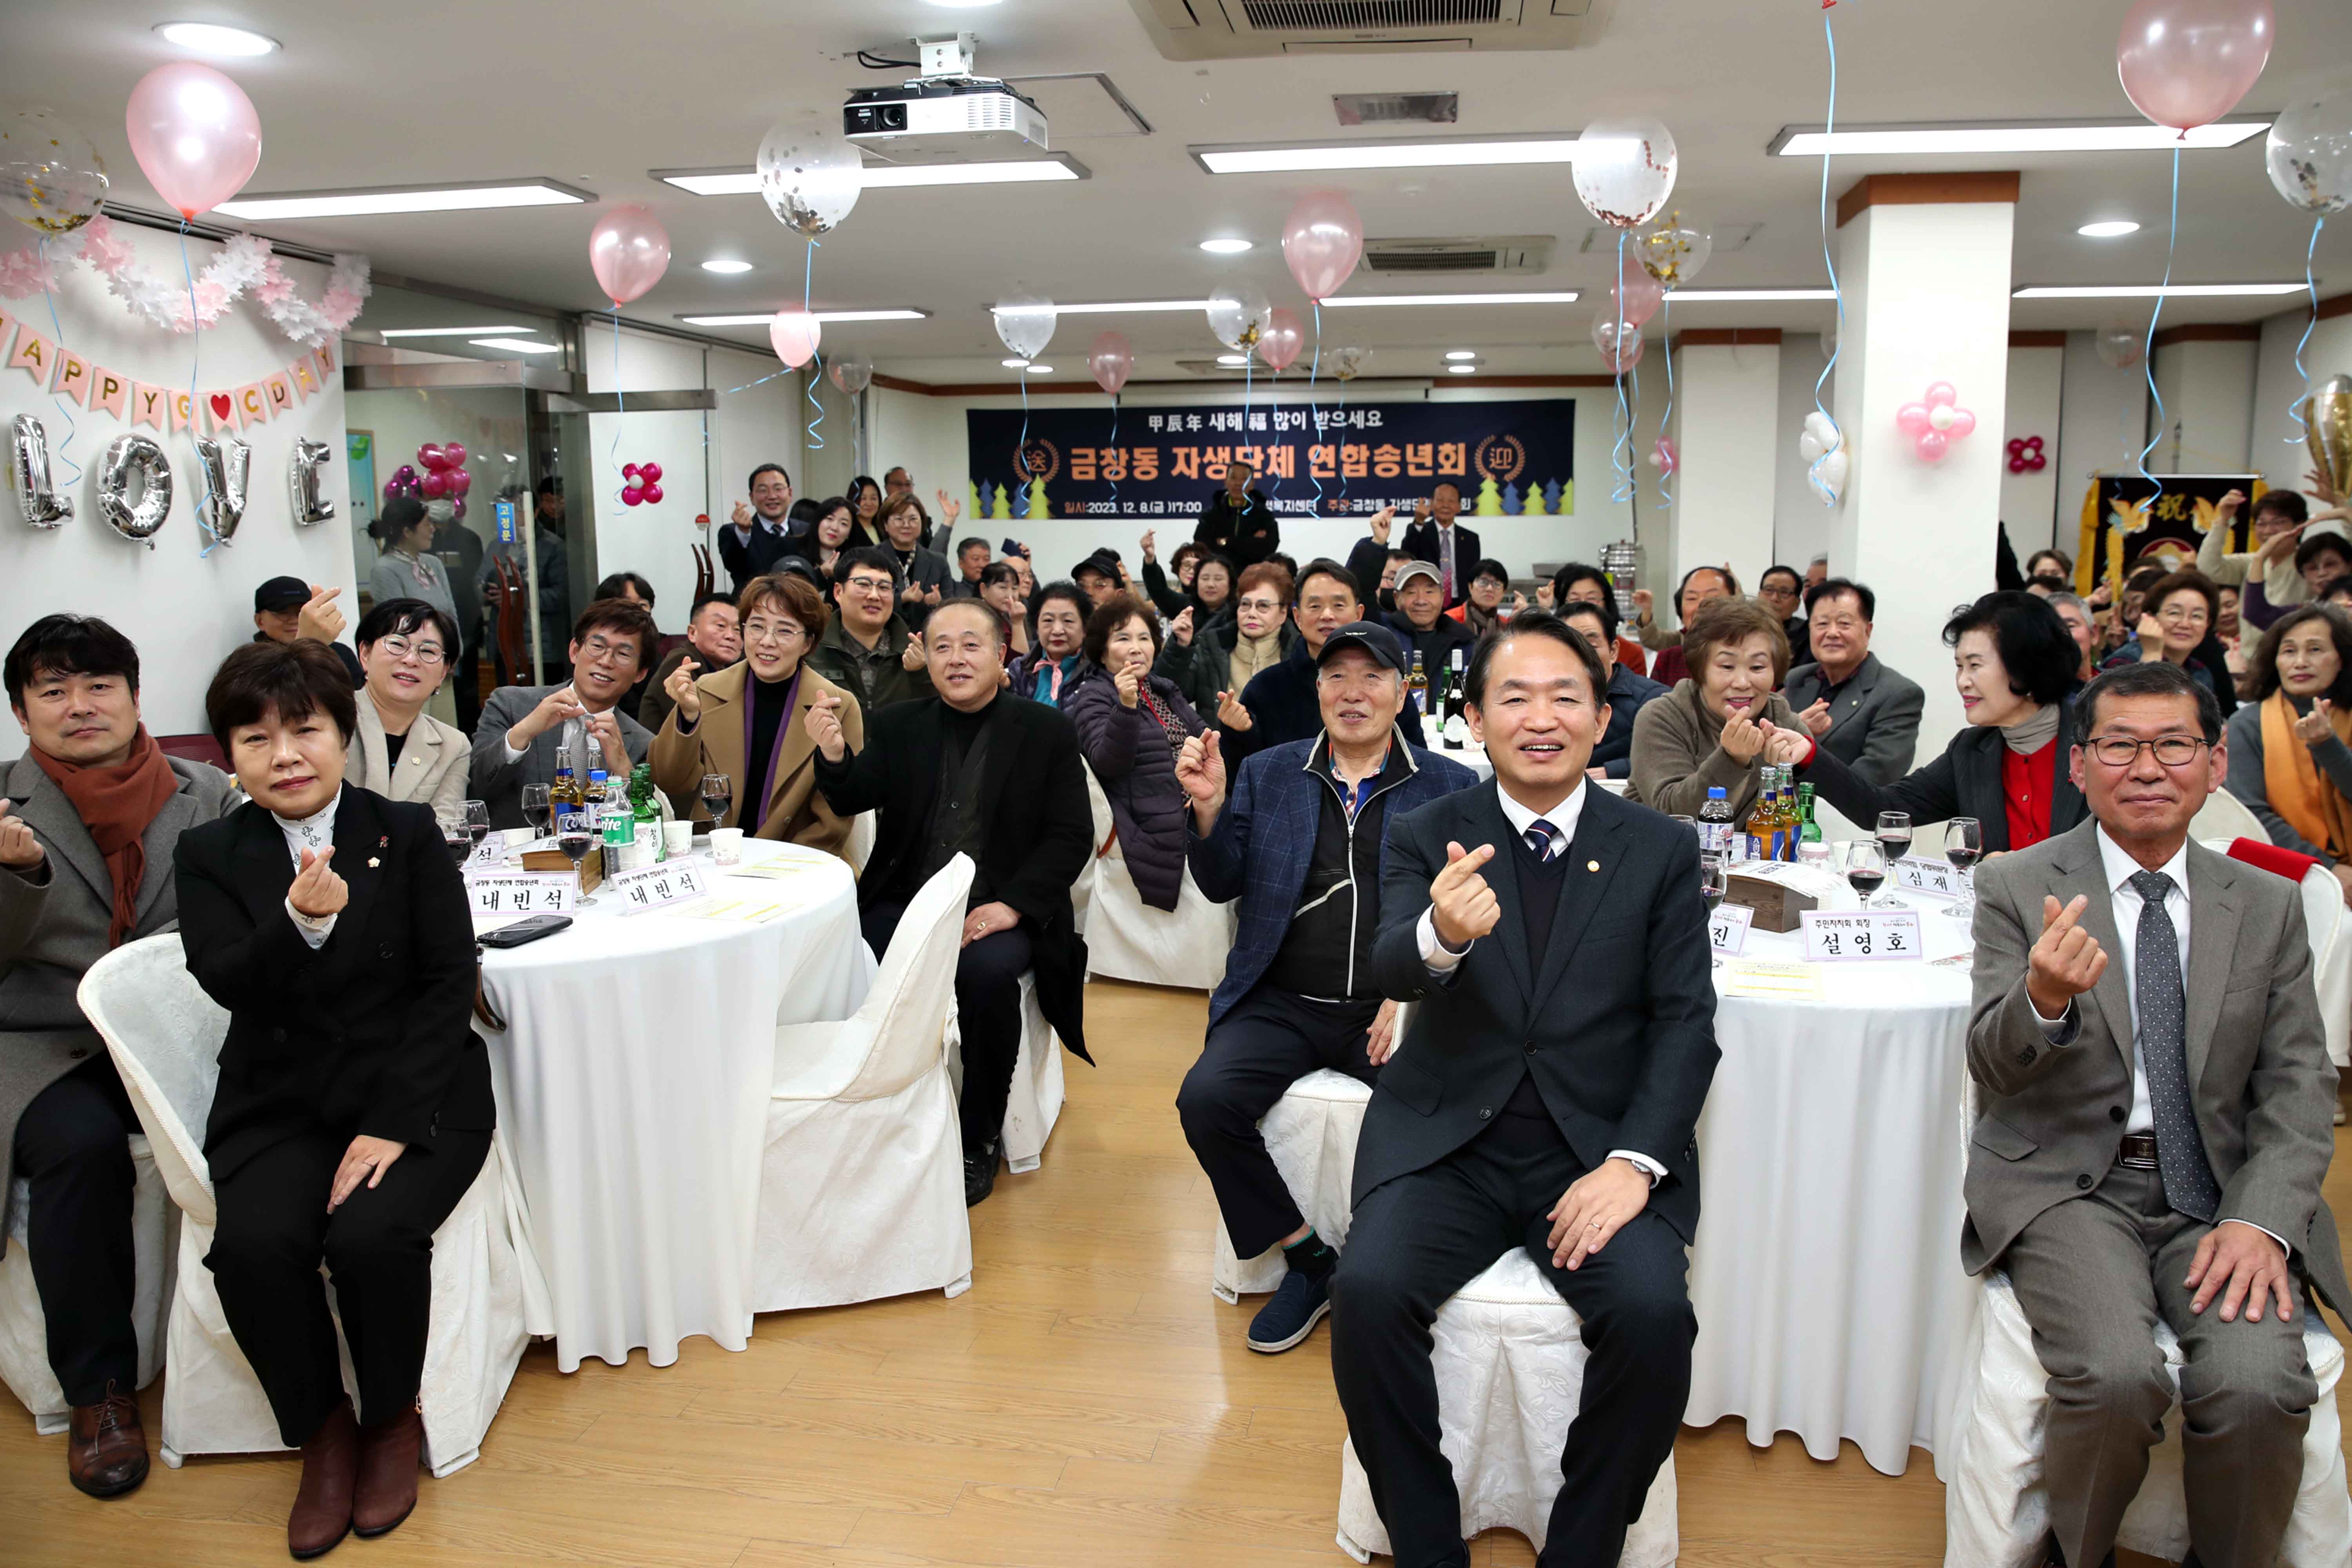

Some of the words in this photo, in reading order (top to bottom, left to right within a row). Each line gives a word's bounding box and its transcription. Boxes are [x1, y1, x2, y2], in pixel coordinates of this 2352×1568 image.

[1209, 413, 1243, 431] 새해
[1248, 412, 1267, 431] 福
[1273, 411, 1306, 430] 많이
[1313, 410, 1383, 429] 받으세요
[1071, 448, 1159, 481] 금창동
[1170, 445, 1294, 480] 자생단체
[1308, 443, 1466, 479] 연합송년회
[1490, 447, 1513, 469] 迎
[1123, 502, 1137, 514] 12.
[2157, 493, 2187, 521] 祝
[1856, 919, 1870, 928] 회장
[1713, 926, 1728, 947] 진
